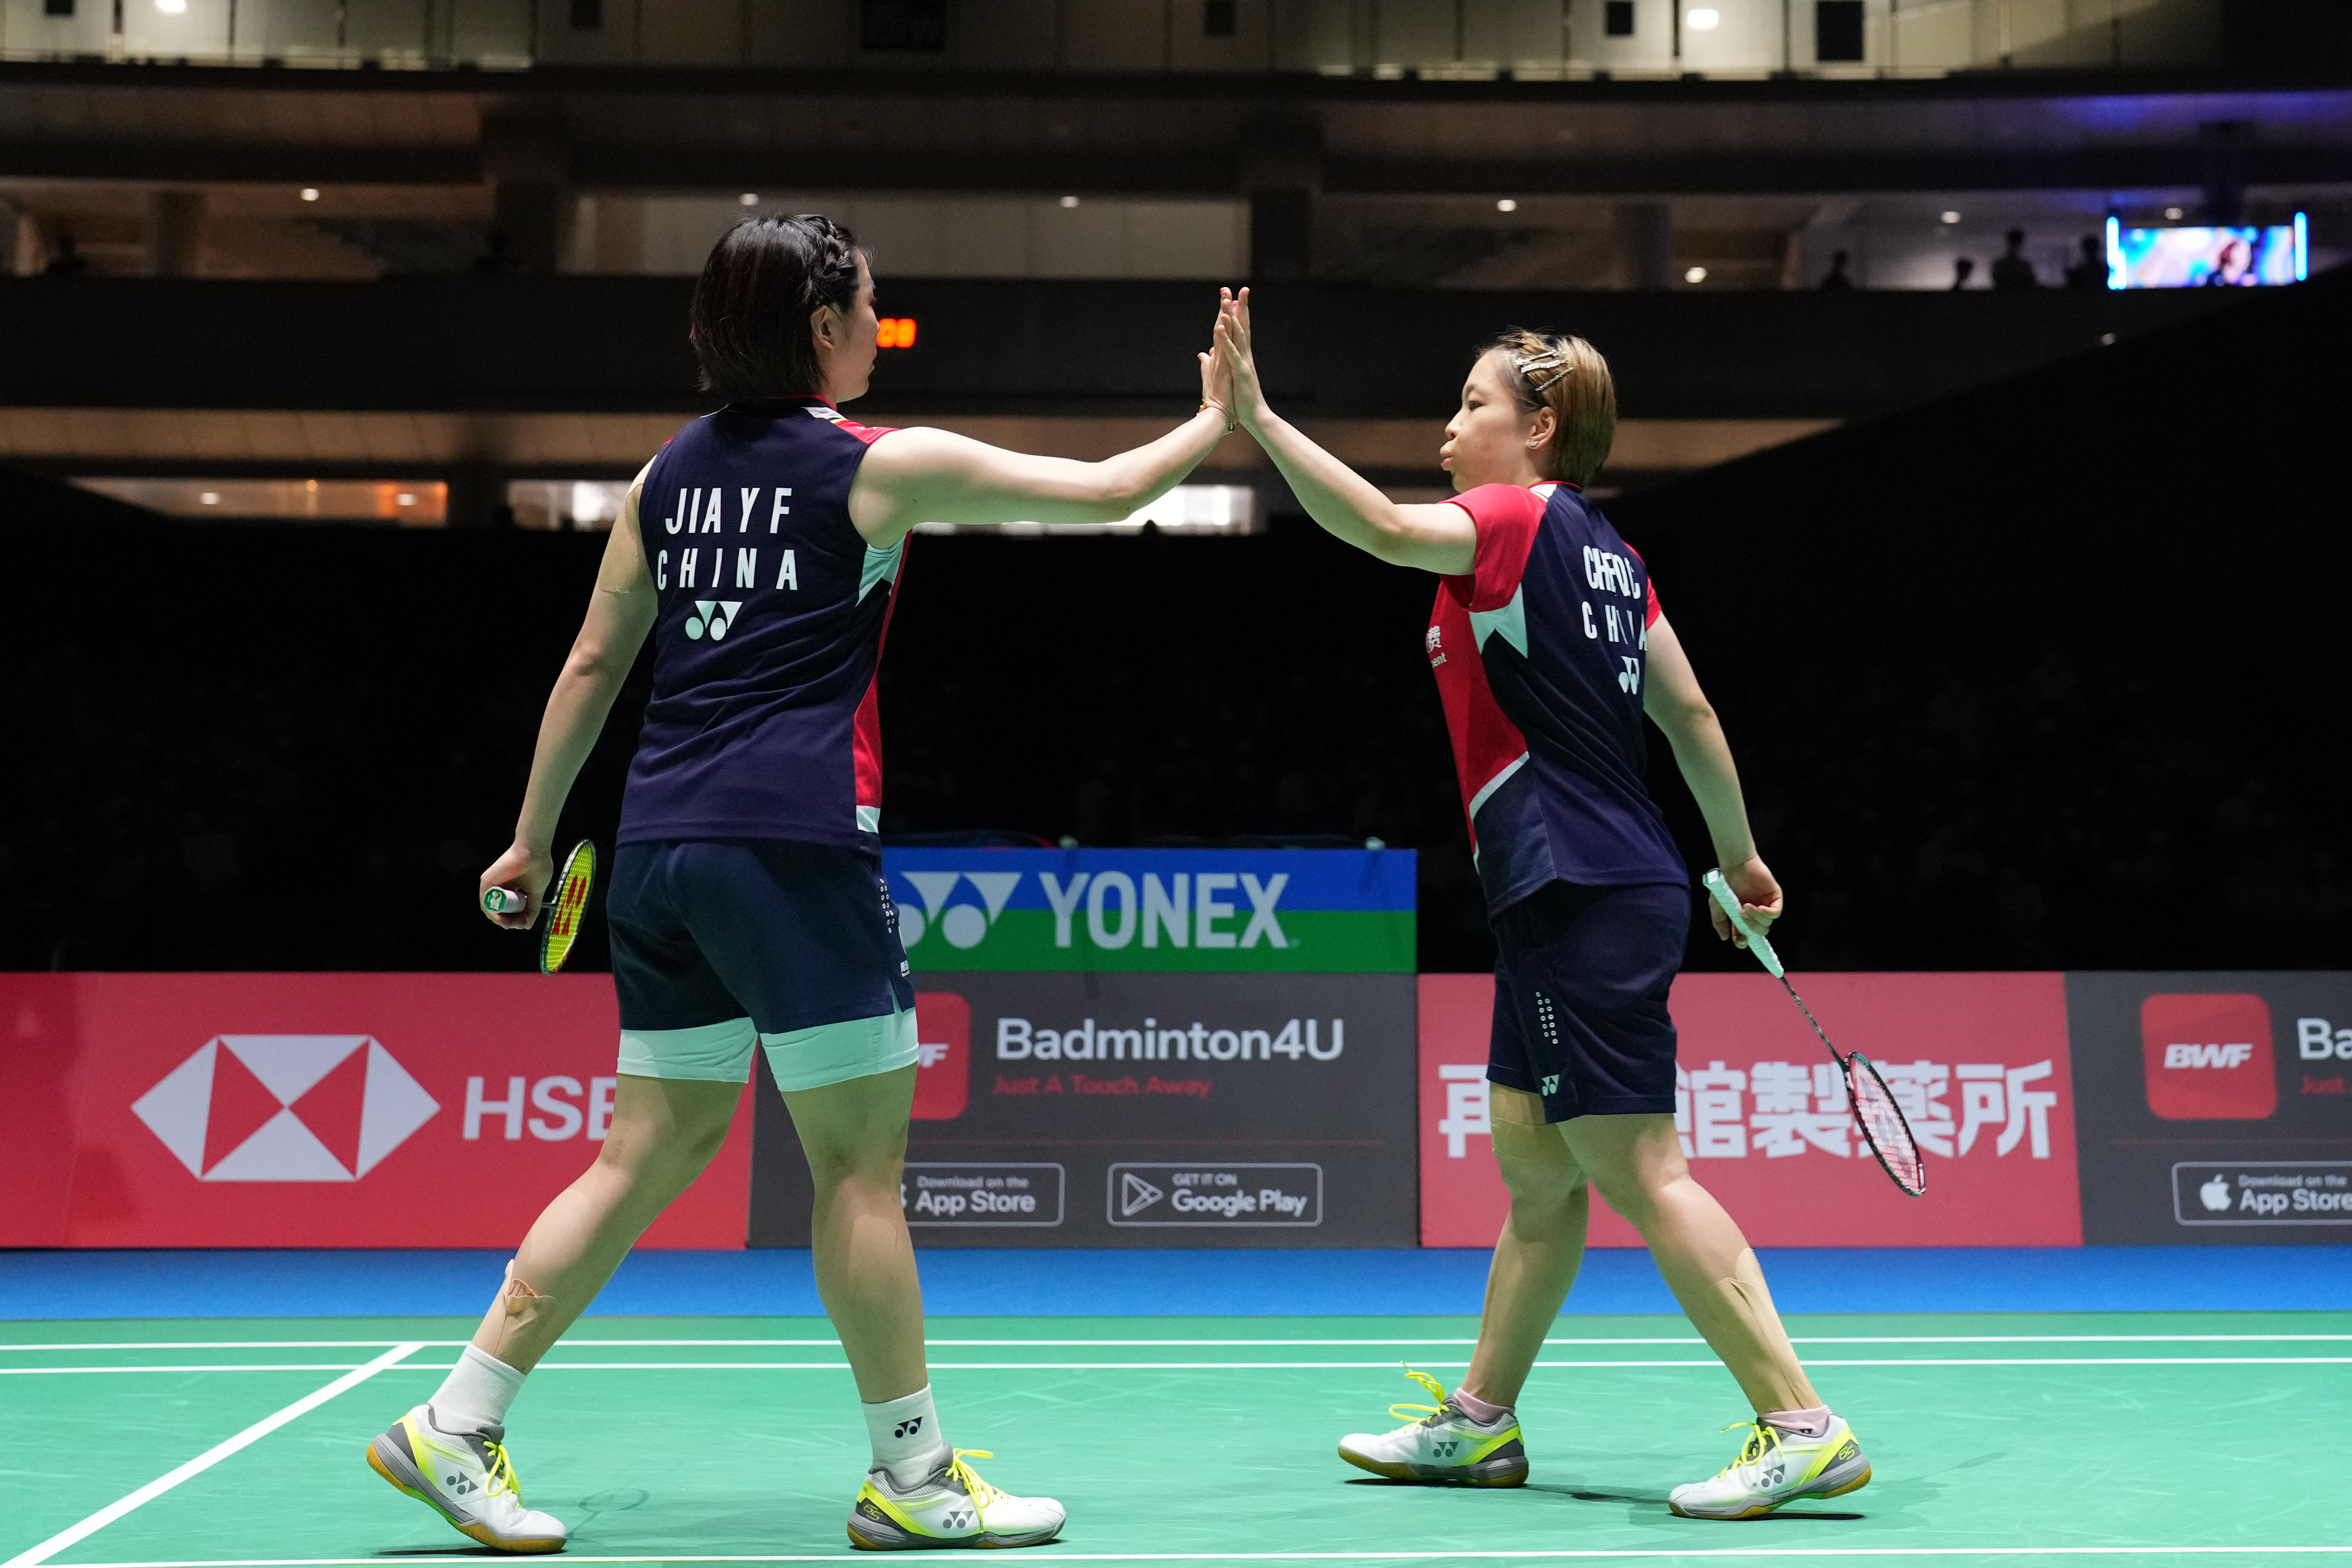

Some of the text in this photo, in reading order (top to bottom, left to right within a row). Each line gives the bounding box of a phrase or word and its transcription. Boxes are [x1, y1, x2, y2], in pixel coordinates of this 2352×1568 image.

[657, 547, 798, 590] CHINA
[1038, 871, 1290, 950] YONEX
[997, 1018, 1344, 1060] Badminton4U
[2164, 1044, 2253, 1069] BWF
[994, 1075, 1212, 1099] Just A Touch Away
[915, 1189, 1036, 1216] App Store
[1171, 1188, 1307, 1217] Google Play
[2239, 1189, 2290, 1216] App
[1839, 1445, 1855, 1460] 65
[863, 1504, 883, 1520] 65
